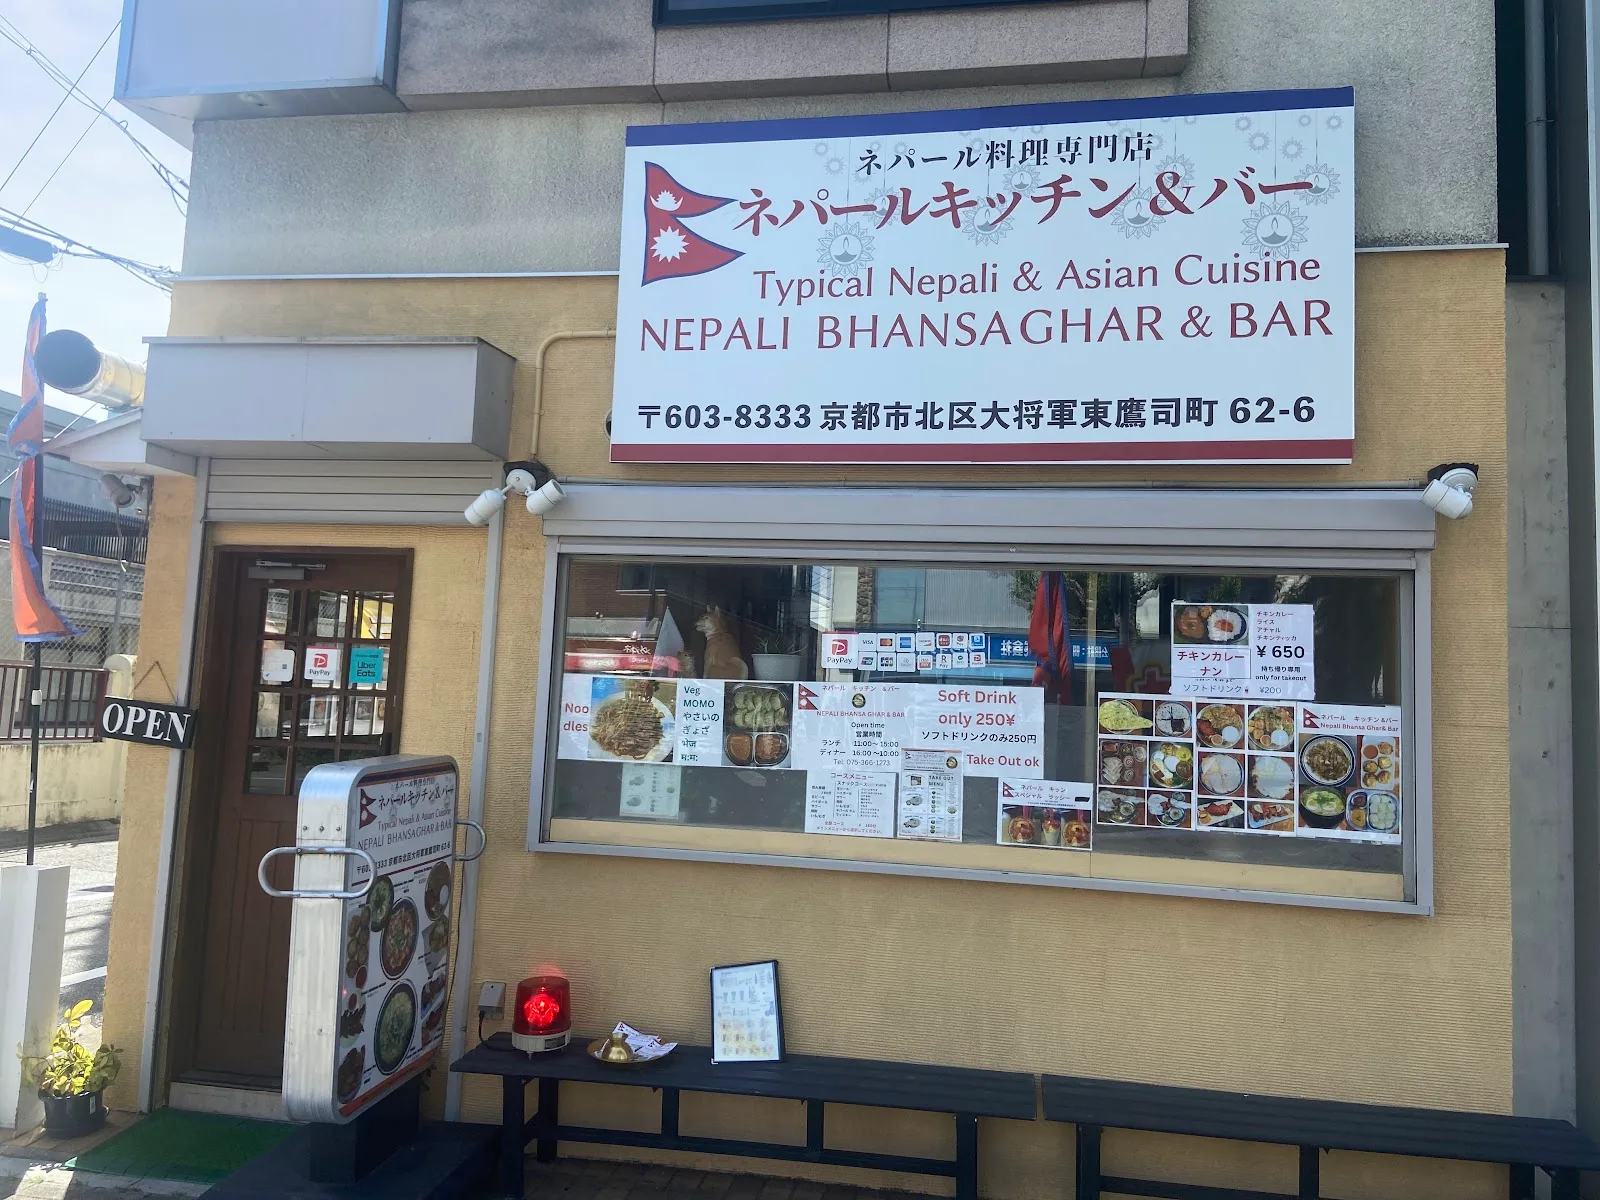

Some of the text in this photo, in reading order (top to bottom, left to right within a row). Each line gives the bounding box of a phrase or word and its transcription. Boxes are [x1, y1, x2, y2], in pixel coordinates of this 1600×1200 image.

[856, 131, 1152, 175] ネパール料理専門店
[753, 251, 1320, 306] Typical Nepali & Asian Cuisine
[640, 298, 1334, 352] NEPALI BHANSAGHAR & BAR
[637, 395, 1316, 431] 〒603-8333 京都市北区大将軍東鷹司町 62-6
[1177, 650, 1245, 662] チキンカレー
[1256, 645, 1305, 658] ¥ 650
[357, 661, 377, 669] Uber
[827, 656, 853, 665] PayPay
[309, 668, 331, 678] PayPay
[356, 669, 377, 678] Eats
[1200, 666, 1222, 676] ナン
[1261, 665, 1301, 673] 持ち帰り専用
[684, 686, 701, 697] Veg
[1183, 684, 1282, 694] ソフトドリンク ¥200
[937, 689, 1017, 704] Soft Drink
[564, 702, 590, 715] Noo
[683, 699, 715, 708] MOMO
[683, 711, 720, 722] やさいの
[938, 711, 1015, 728] only 250¥
[102, 702, 192, 743] OPEN
[563, 720, 588, 732] dles
[850, 721, 869, 730] Open
[1320, 722, 1341, 730] Nepali
[1342, 723, 1366, 731] Bhansa
[855, 730, 883, 738] 営業時間
[921, 731, 1037, 744] ソフトドリンクのみ250円
[821, 739, 841, 747] ランチ
[819, 748, 846, 756] ディナー
[966, 753, 1040, 767] Take Out ok
[831, 772, 874, 780] コースメニュー
[378, 817, 398, 832] Typical
[421, 811, 435, 821] Asian
[358, 834, 385, 852] NEPALI
[440, 818, 452, 831] BAR
